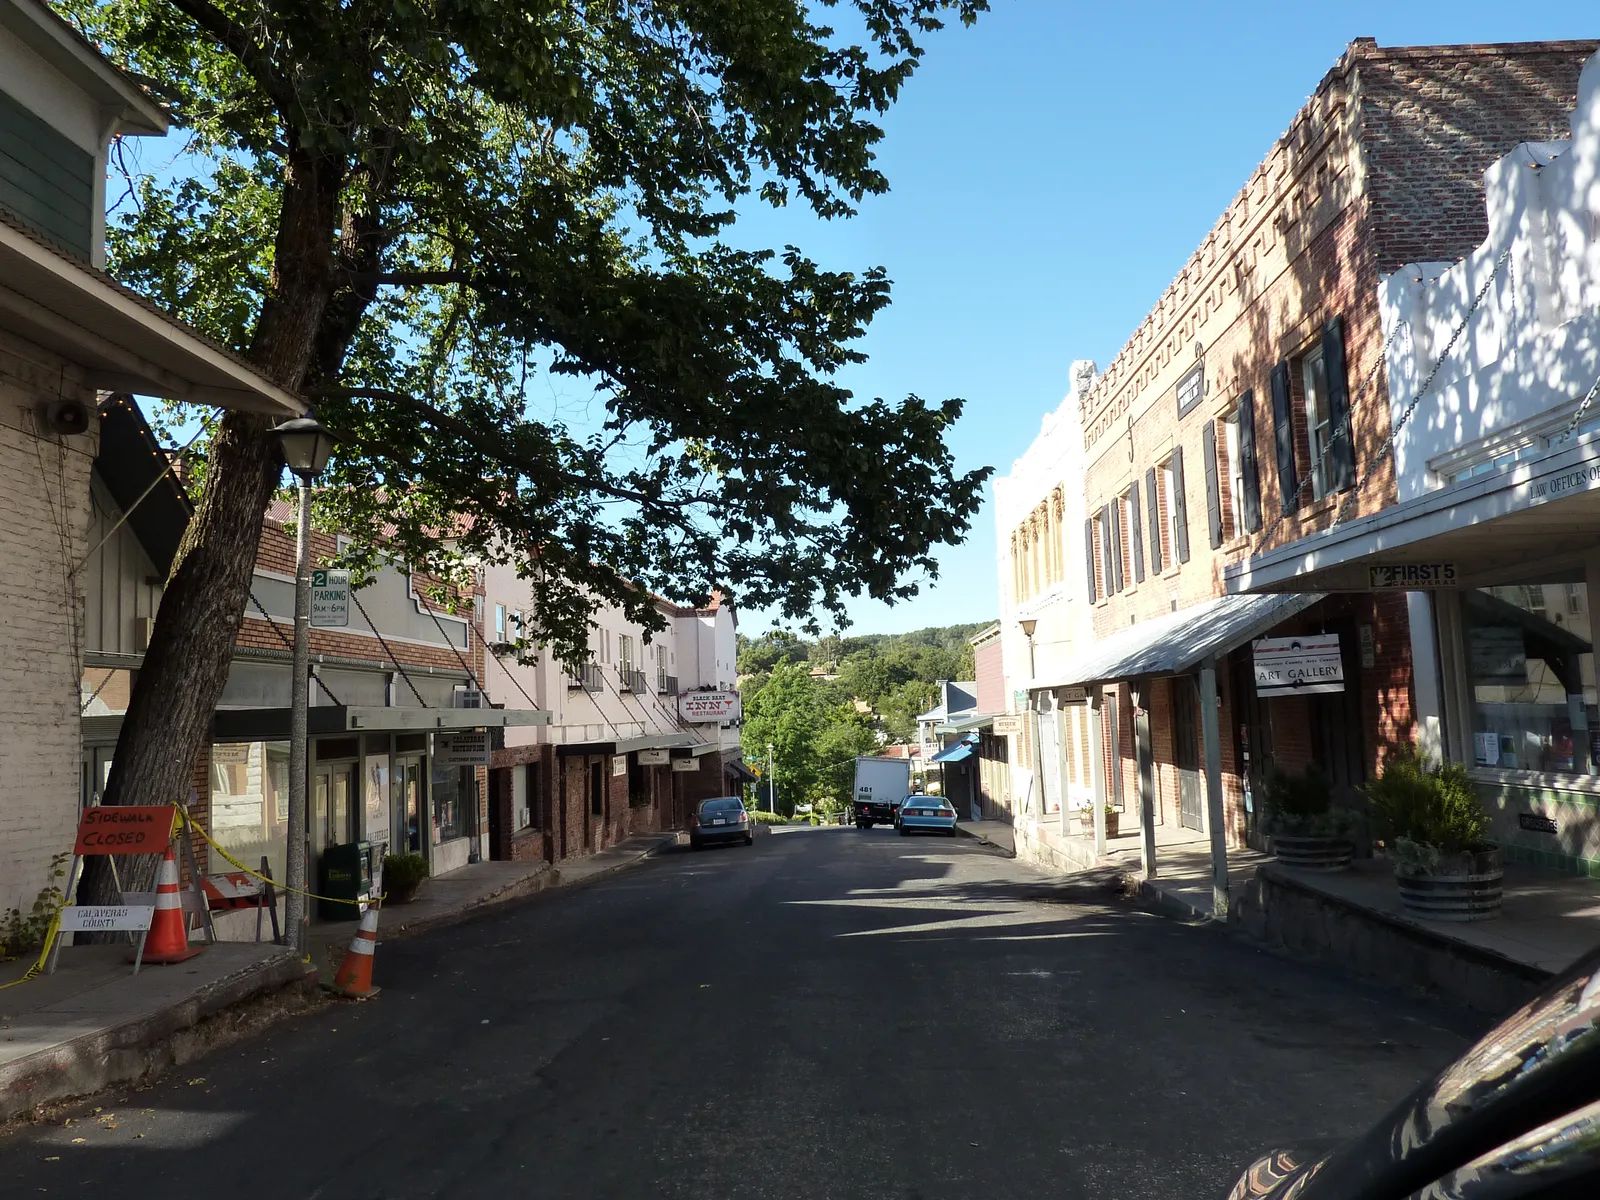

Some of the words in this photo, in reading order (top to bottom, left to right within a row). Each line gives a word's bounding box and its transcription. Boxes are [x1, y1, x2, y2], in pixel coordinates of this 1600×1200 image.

[1530, 482, 1548, 499] LAW
[1550, 470, 1587, 493] OFFICES
[1392, 564, 1441, 579] FIRST
[1444, 564, 1455, 578] 5
[315, 573, 325, 585] 2
[328, 575, 347, 584] HOUR
[314, 591, 346, 601] PARKING
[1259, 670, 1281, 681] ART
[1287, 666, 1338, 679] GALLERY
[686, 701, 722, 710] INN
[84, 810, 155, 824] SIDEWALK
[82, 831, 145, 846] CLOSED
[77, 908, 128, 919] CALAVERAS
[82, 918, 117, 928] COUNTY
